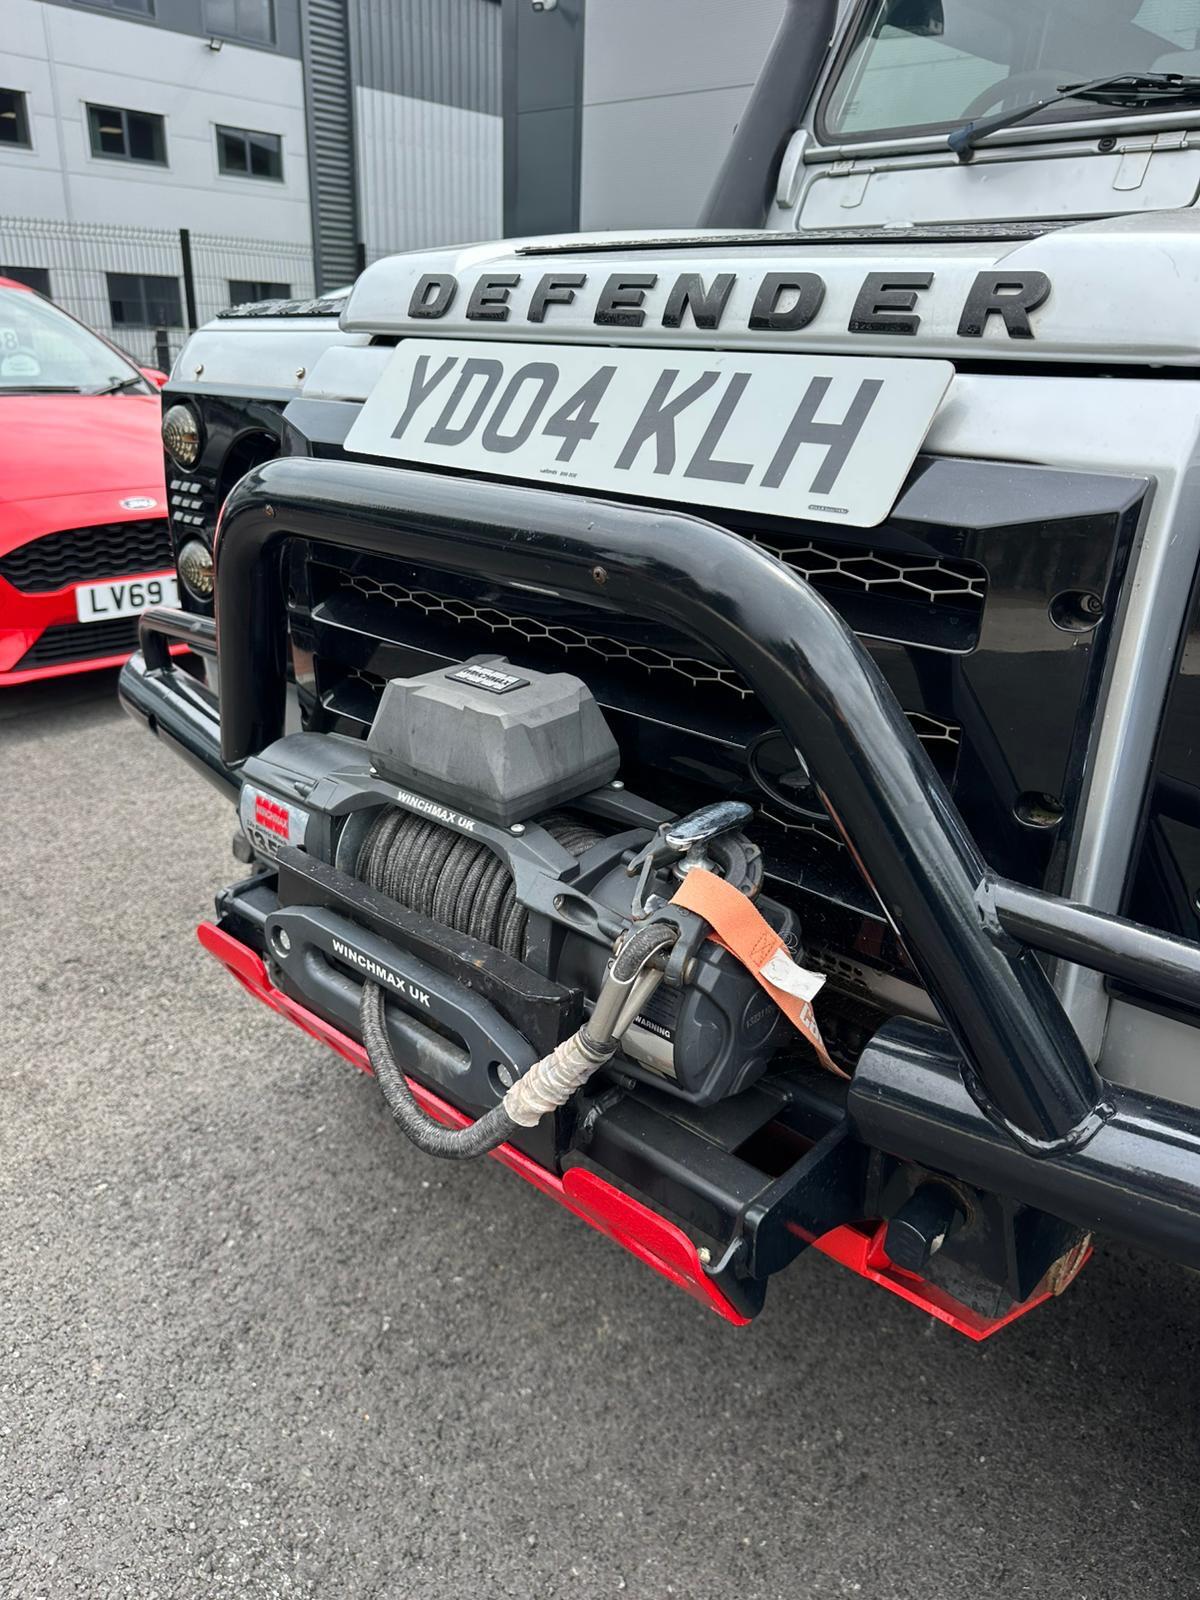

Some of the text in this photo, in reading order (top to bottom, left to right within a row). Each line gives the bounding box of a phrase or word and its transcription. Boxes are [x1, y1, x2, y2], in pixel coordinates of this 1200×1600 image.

[407, 271, 1052, 339] DEFENDER
[391, 354, 884, 495] YD04 KLH
[90, 581, 163, 613] LV69
[397, 791, 476, 831] WINCHMAX UK
[332, 939, 430, 1007] WINCHMAX UK
[634, 1015, 671, 1038] WARNING
